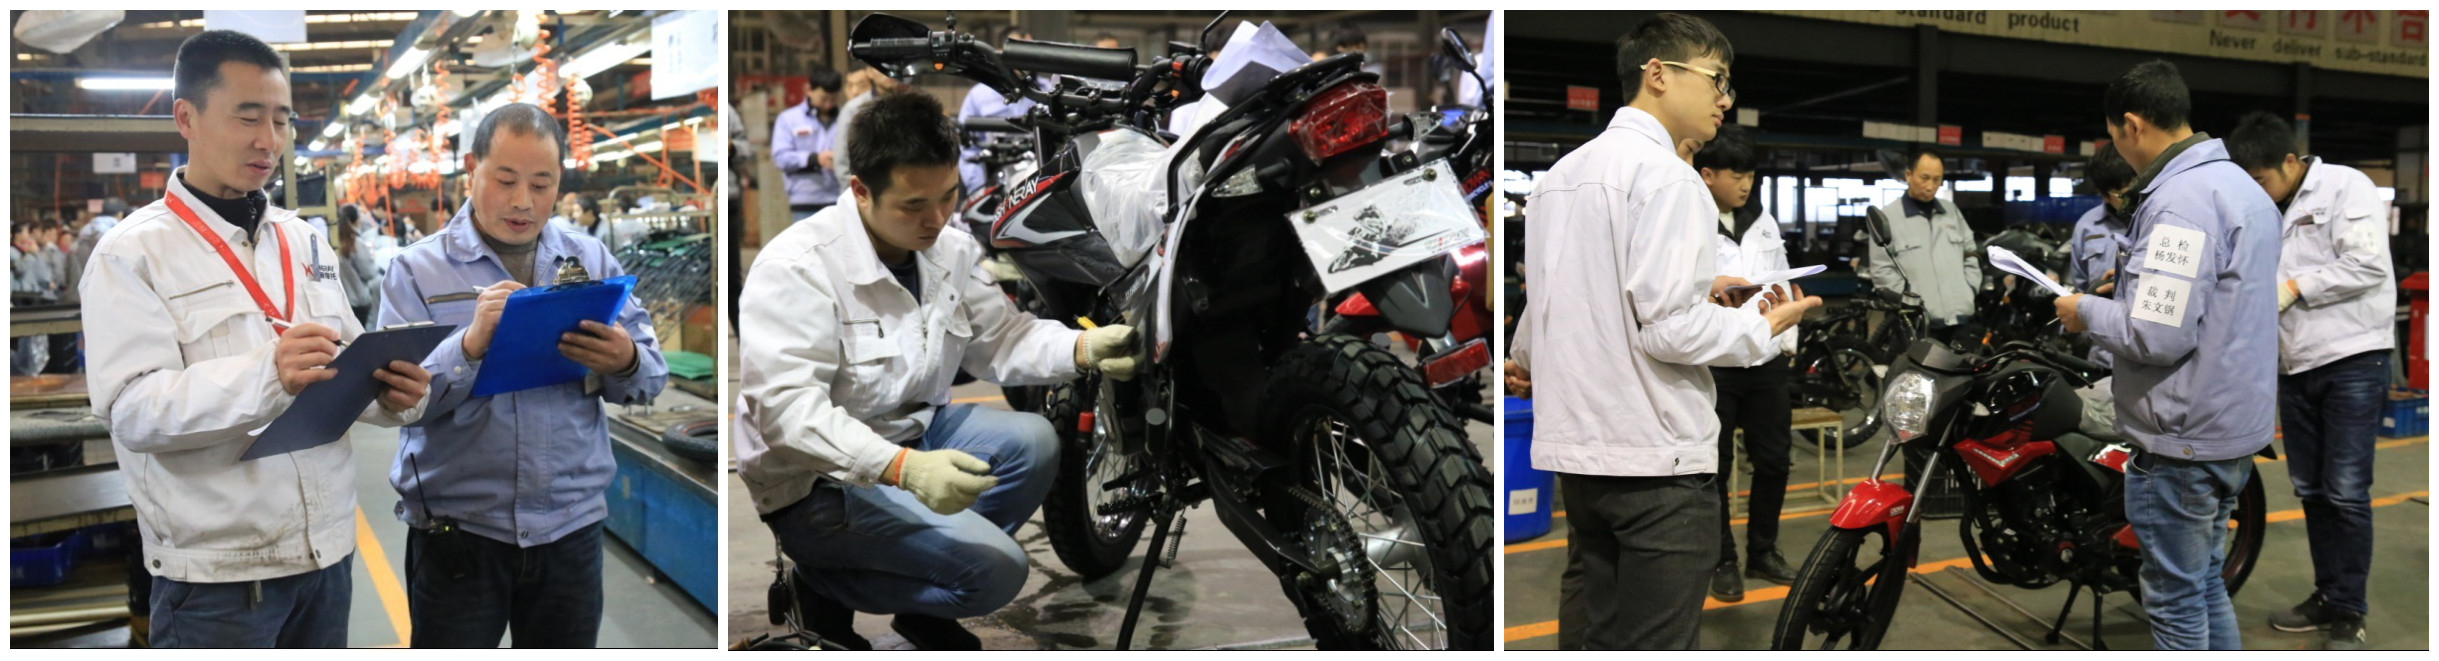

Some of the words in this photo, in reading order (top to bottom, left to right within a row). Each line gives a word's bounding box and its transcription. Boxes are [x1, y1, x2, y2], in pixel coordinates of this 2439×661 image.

[2008, 12, 2079, 32] product
[2209, 29, 2257, 49] Never
[2272, 37, 2322, 57] deliver
[2147, 286, 2177, 302] 裁判
